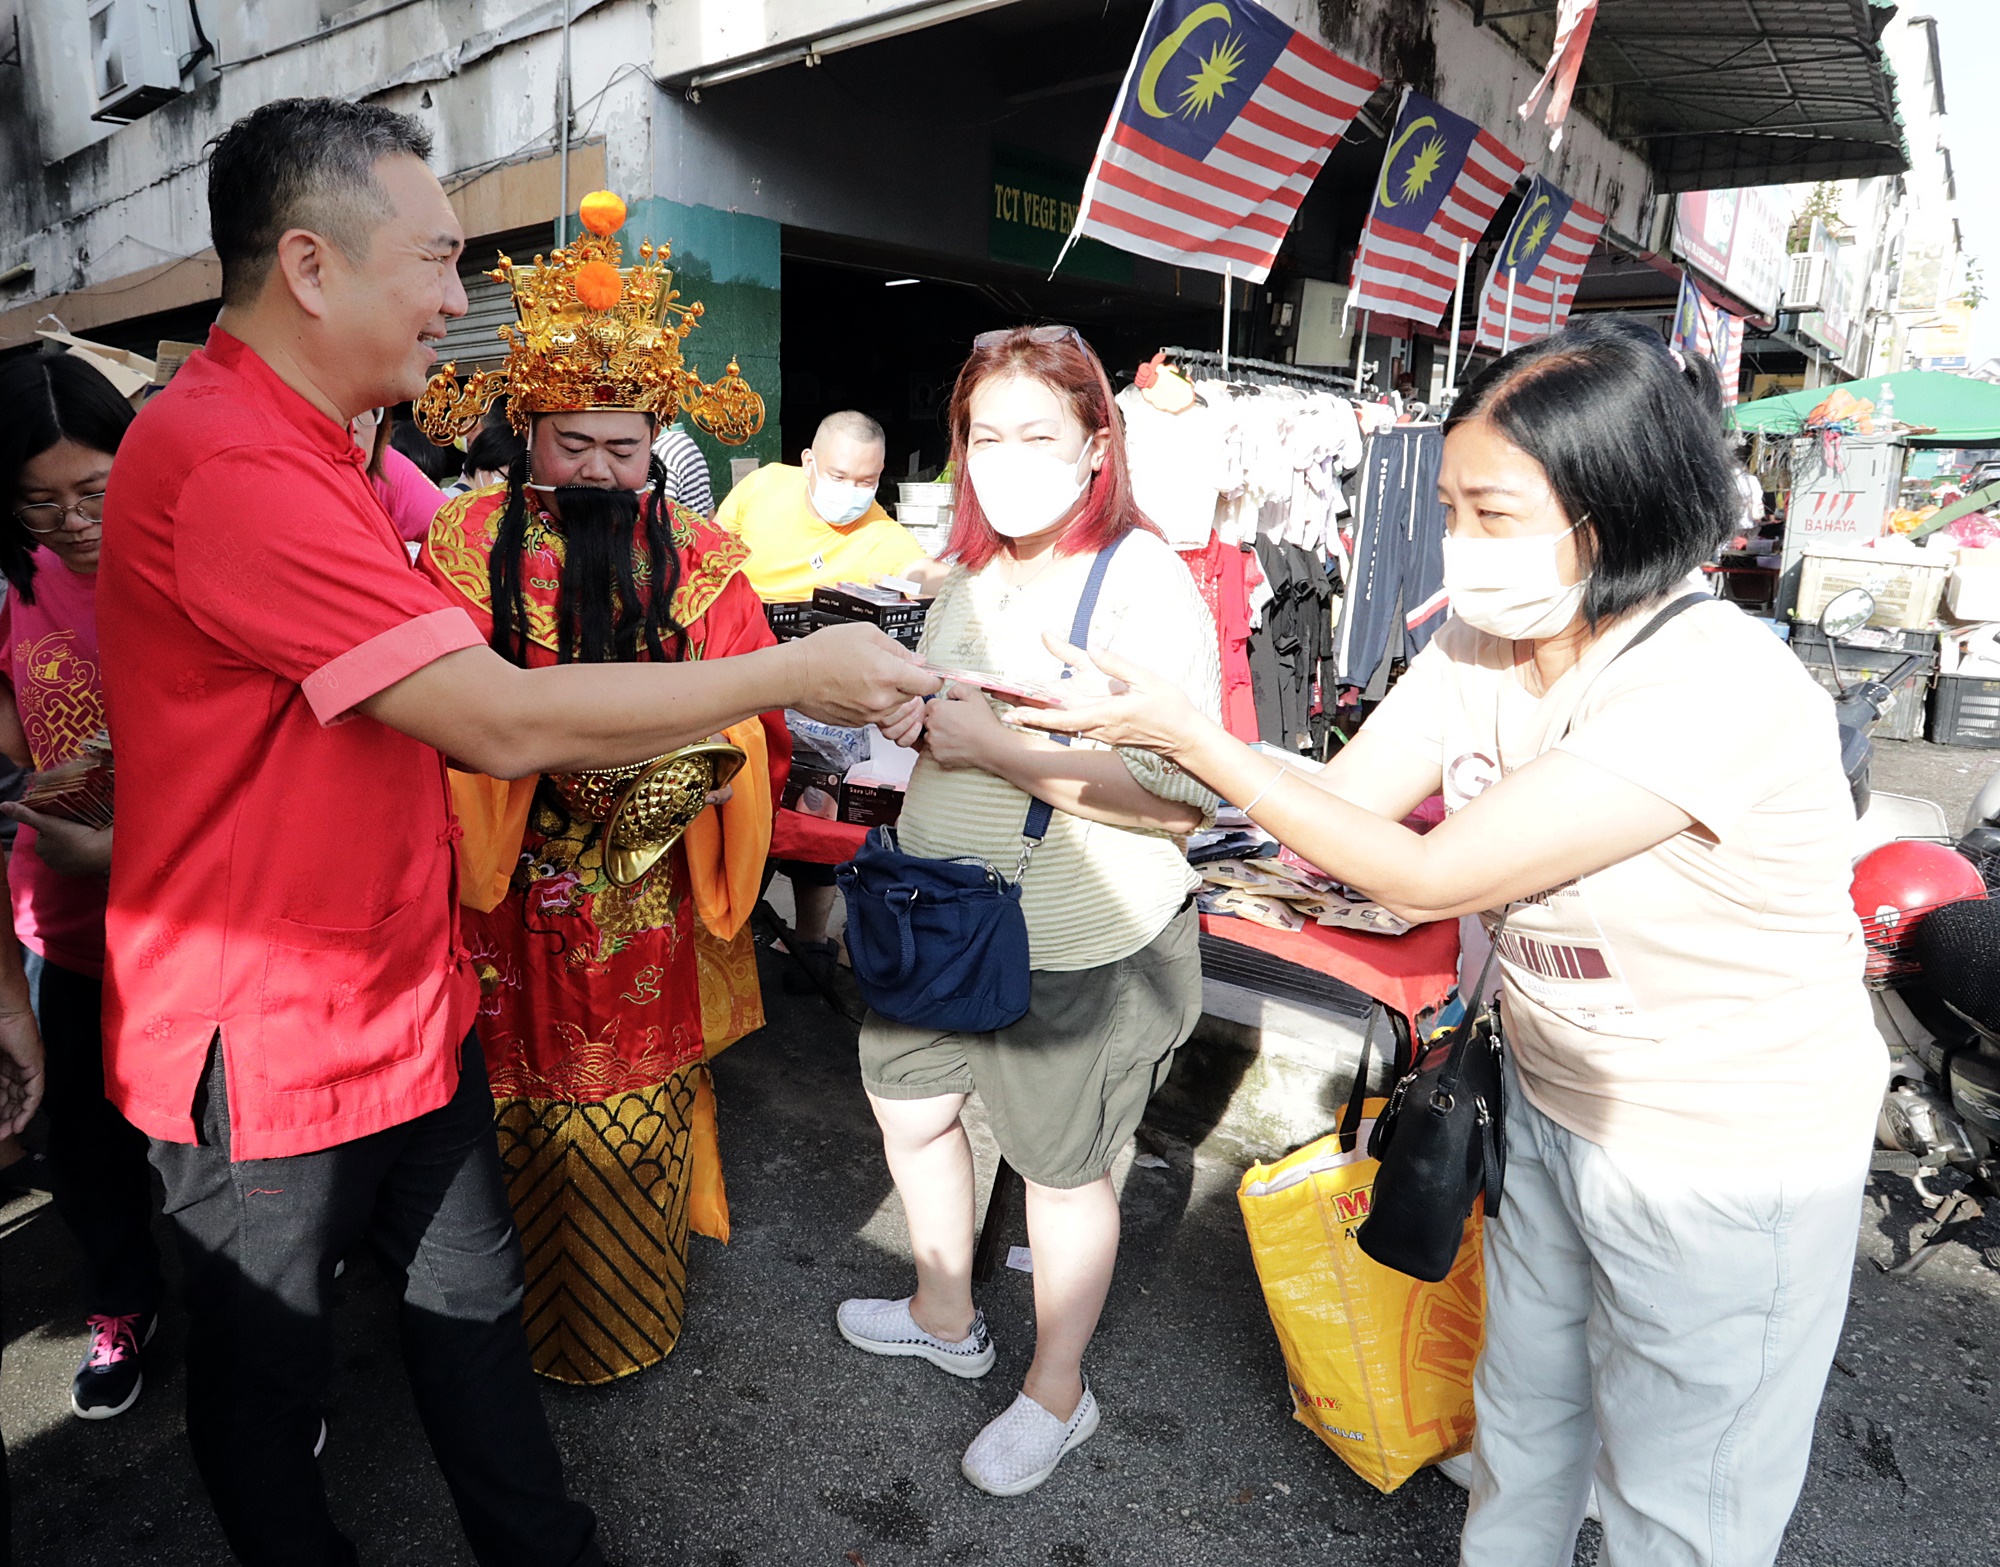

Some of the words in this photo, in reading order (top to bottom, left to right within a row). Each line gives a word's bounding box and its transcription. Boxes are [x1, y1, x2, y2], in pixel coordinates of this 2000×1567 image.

[994, 183, 1021, 223] TCT
[1022, 191, 1057, 232] VEGE
[1059, 201, 1080, 235] EN
[1804, 518, 1857, 533] BAHAYA
[821, 725, 858, 751] MASK
